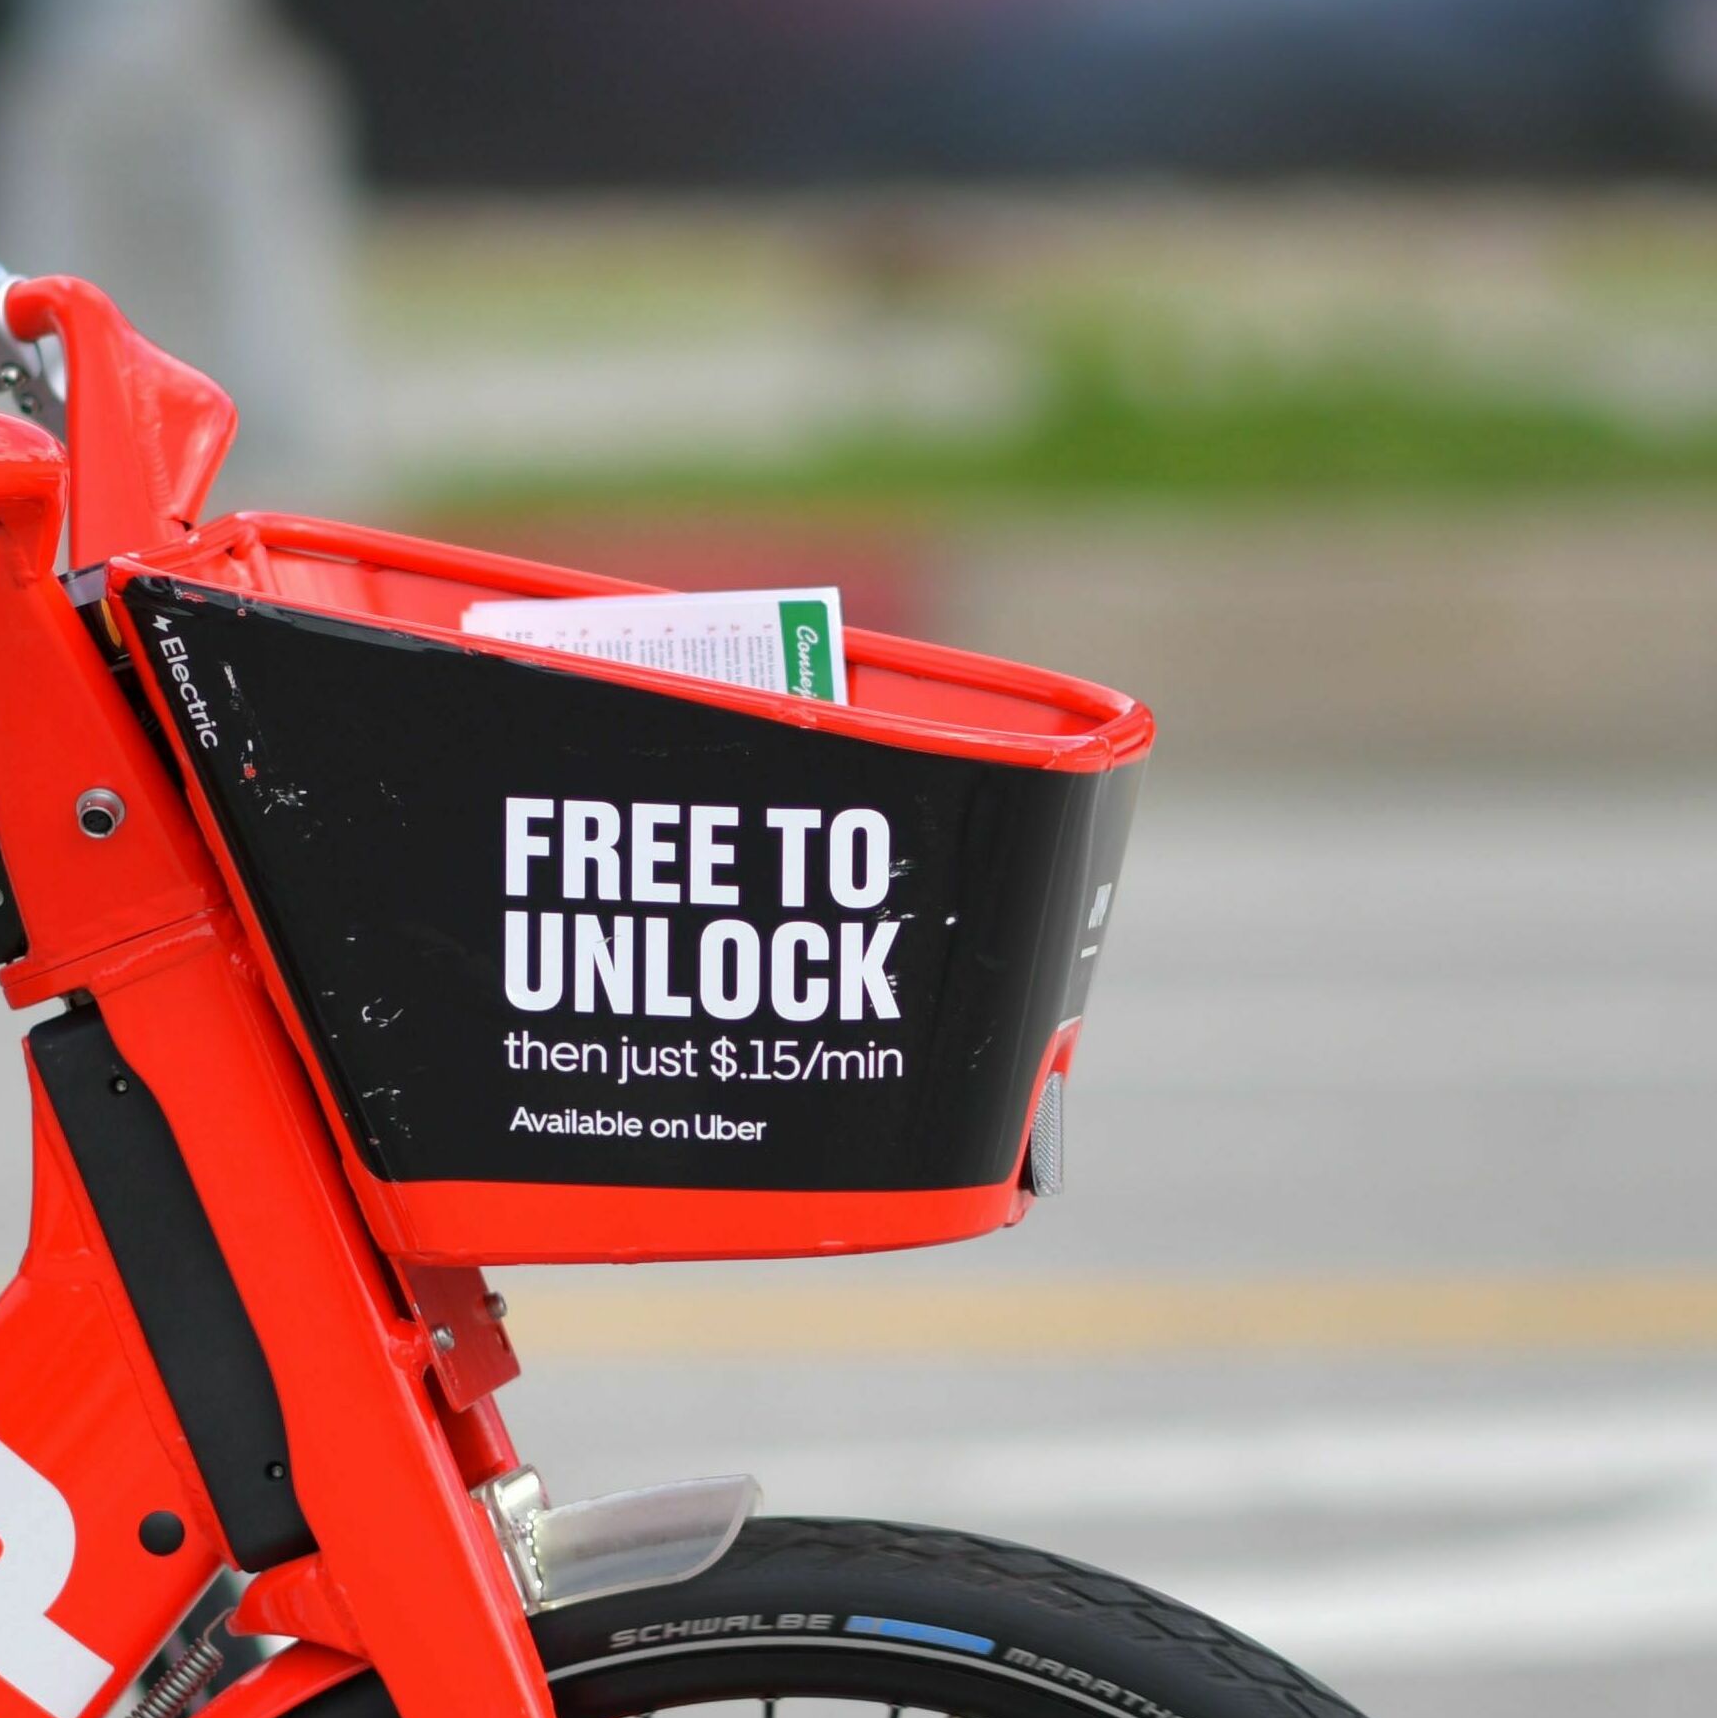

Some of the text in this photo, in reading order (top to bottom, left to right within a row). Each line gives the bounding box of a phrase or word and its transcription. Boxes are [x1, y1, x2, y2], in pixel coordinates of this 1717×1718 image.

[159, 636, 218, 749] Electric
[793, 625, 820, 699] Consej
[505, 796, 891, 909] FREE TO
[504, 910, 902, 1021] UNLOCK
[504, 1030, 903, 1085] then just $.15/min
[509, 1106, 767, 1141] Available on Uber
[611, 1613, 834, 1649] SCHWALBE
